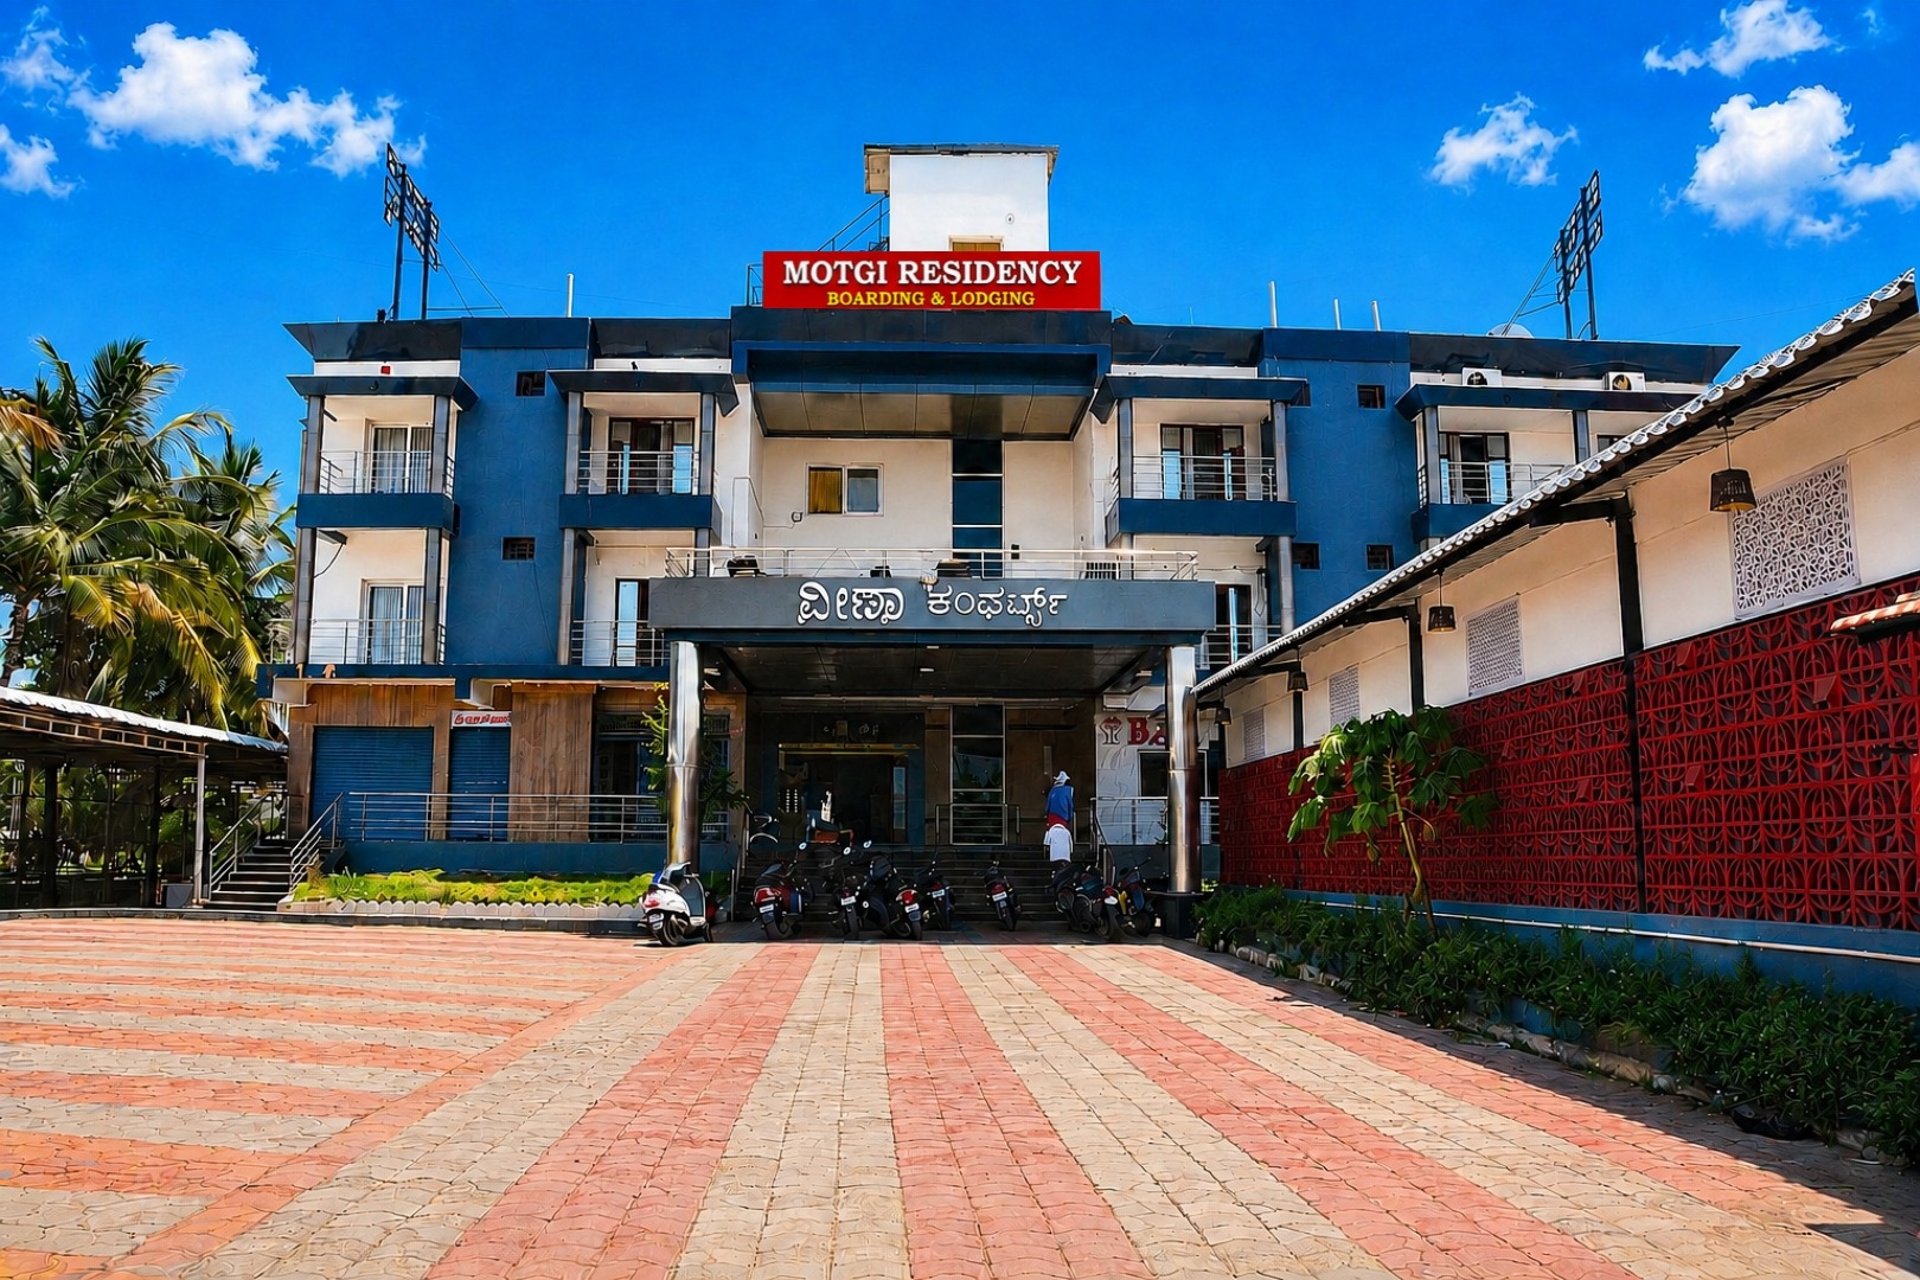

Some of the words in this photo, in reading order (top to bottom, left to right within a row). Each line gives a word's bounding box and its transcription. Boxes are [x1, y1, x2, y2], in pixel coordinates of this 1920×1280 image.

[783, 260, 888, 285] MOTGI
[898, 260, 1082, 285] RESIDENCY
[827, 291, 925, 306] BOARDING
[931, 291, 946, 306] &
[951, 291, 1036, 306] LODGING
